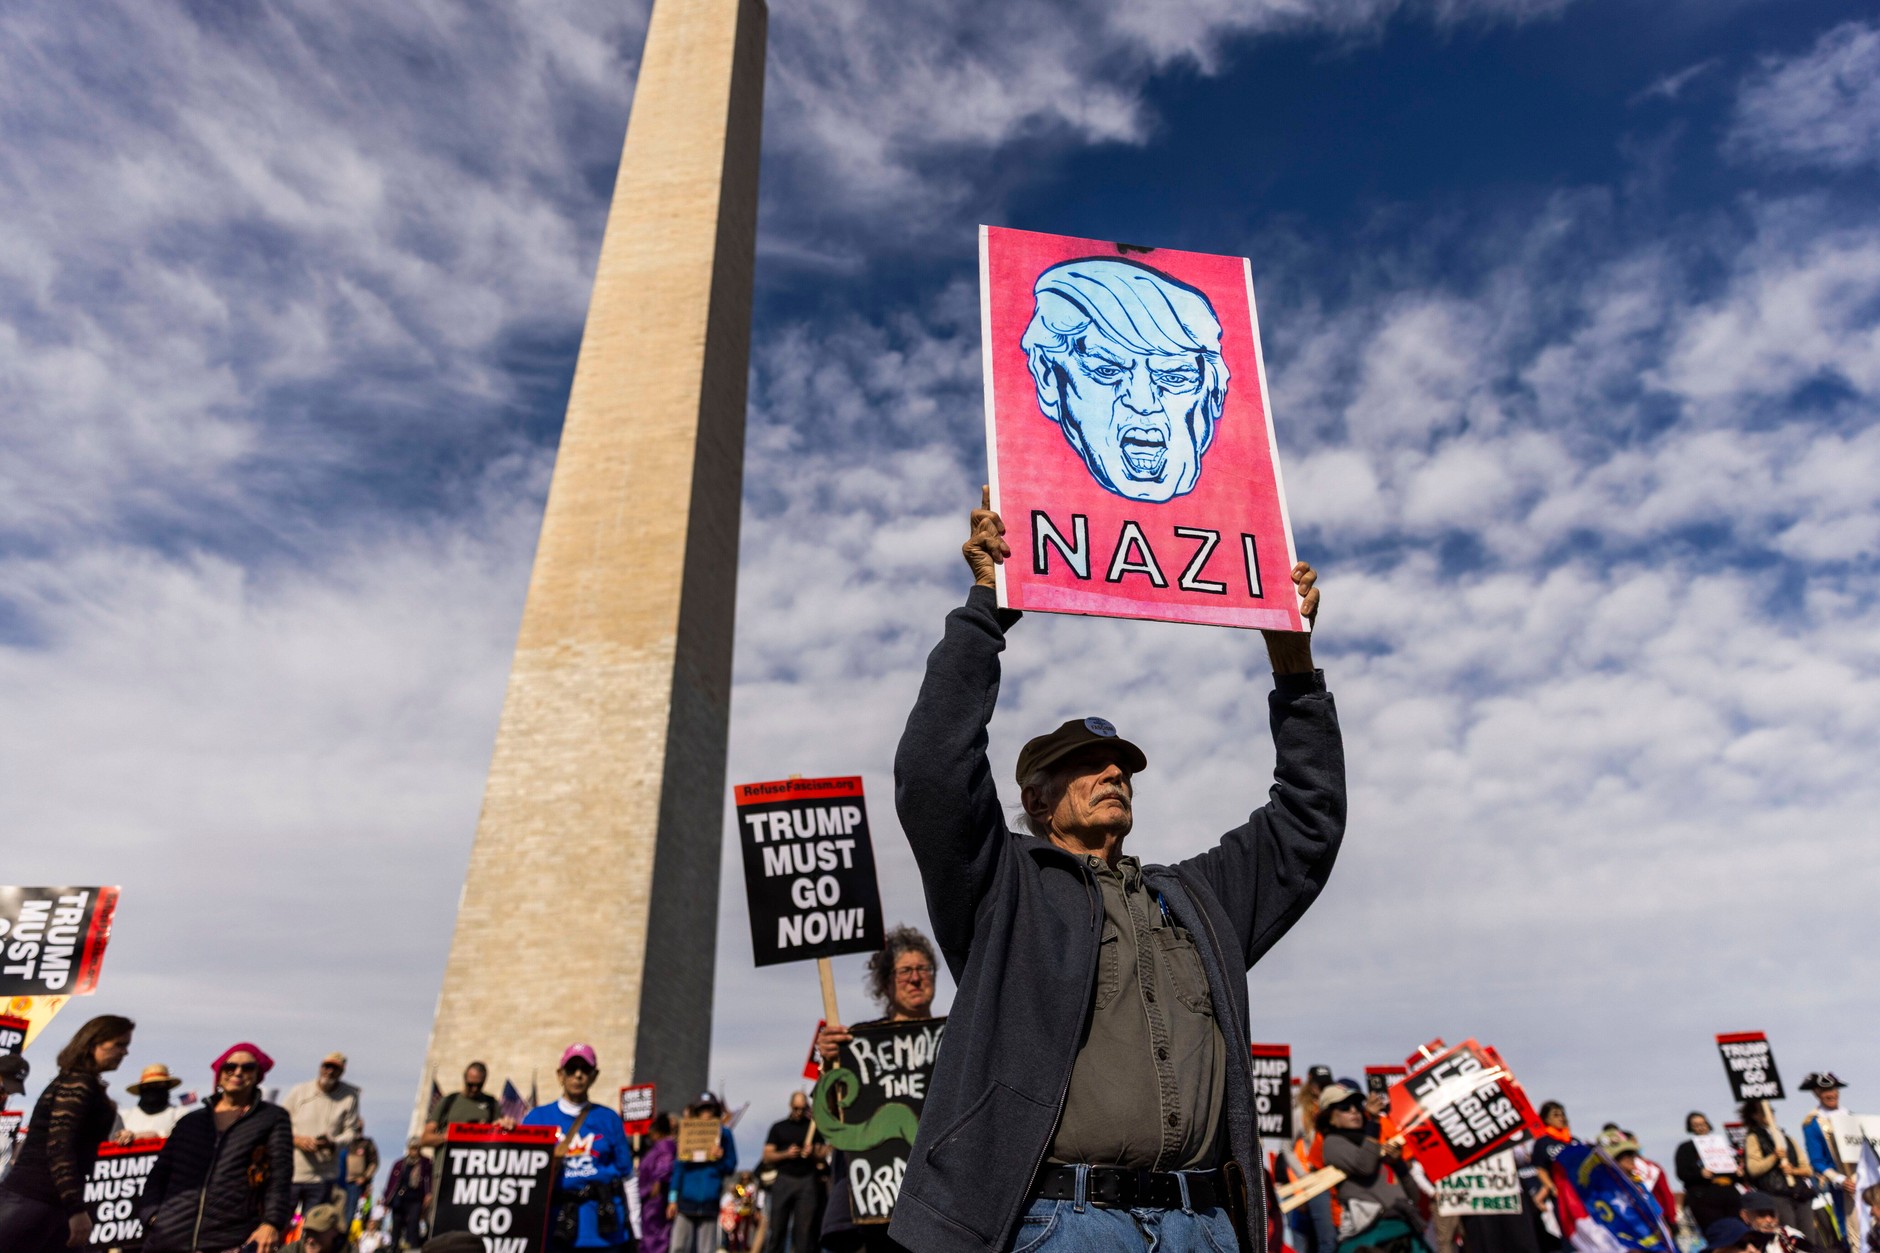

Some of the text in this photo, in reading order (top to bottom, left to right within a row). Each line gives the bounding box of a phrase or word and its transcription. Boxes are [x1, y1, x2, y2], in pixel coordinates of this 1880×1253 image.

[1030, 509, 1264, 599] NAZI
[743, 779, 855, 797] RefuseFascism.org
[745, 805, 862, 843] TRUMP
[762, 839, 856, 877] MUST
[791, 875, 840, 909] GO
[3, 900, 52, 980] MUST
[38, 891, 89, 990] TRUMP
[778, 908, 864, 949] NOW!
[850, 1025, 945, 1085] REMOV
[1720, 1042, 1769, 1059] TRUMP
[1729, 1055, 1770, 1072] MUST
[1253, 1059, 1288, 1077] UMP
[1743, 1068, 1767, 1084] GO
[879, 1073, 925, 1099] THE
[1415, 1077, 1476, 1147] TUMP
[1488, 1096, 1522, 1131] SE
[85, 1155, 159, 1181] RUMP
[450, 1149, 549, 1176] TRUMP
[83, 1176, 147, 1202] MUST
[452, 1178, 537, 1205] MUST
[1441, 1173, 1517, 1190] HATE YOU
[97, 1199, 132, 1222] GO
[1471, 1194, 1518, 1210] FREE!
[468, 1207, 513, 1235] GO
